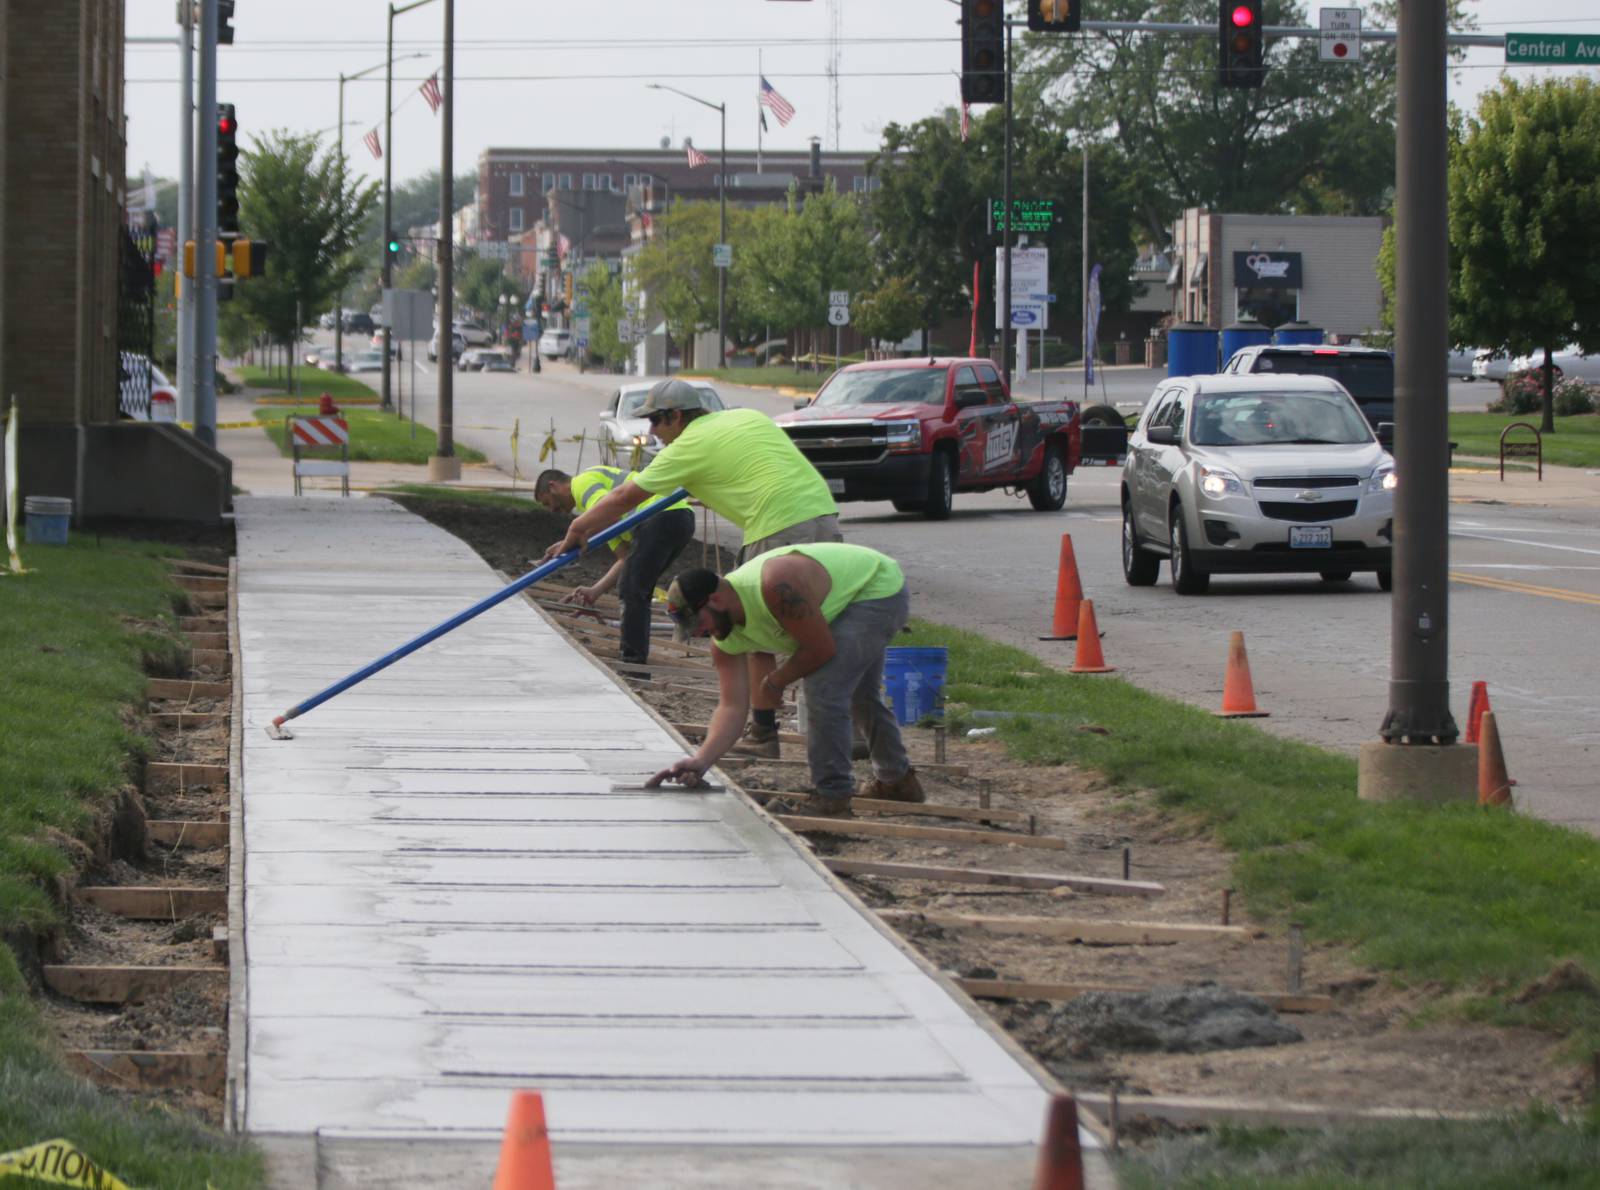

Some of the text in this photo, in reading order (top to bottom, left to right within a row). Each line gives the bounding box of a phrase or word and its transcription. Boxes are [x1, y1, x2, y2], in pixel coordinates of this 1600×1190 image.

[1507, 40, 1566, 57] Central
[832, 293, 848, 303] JCT
[834, 309, 843, 320] 6
[18, 1144, 104, 1187] UTION
